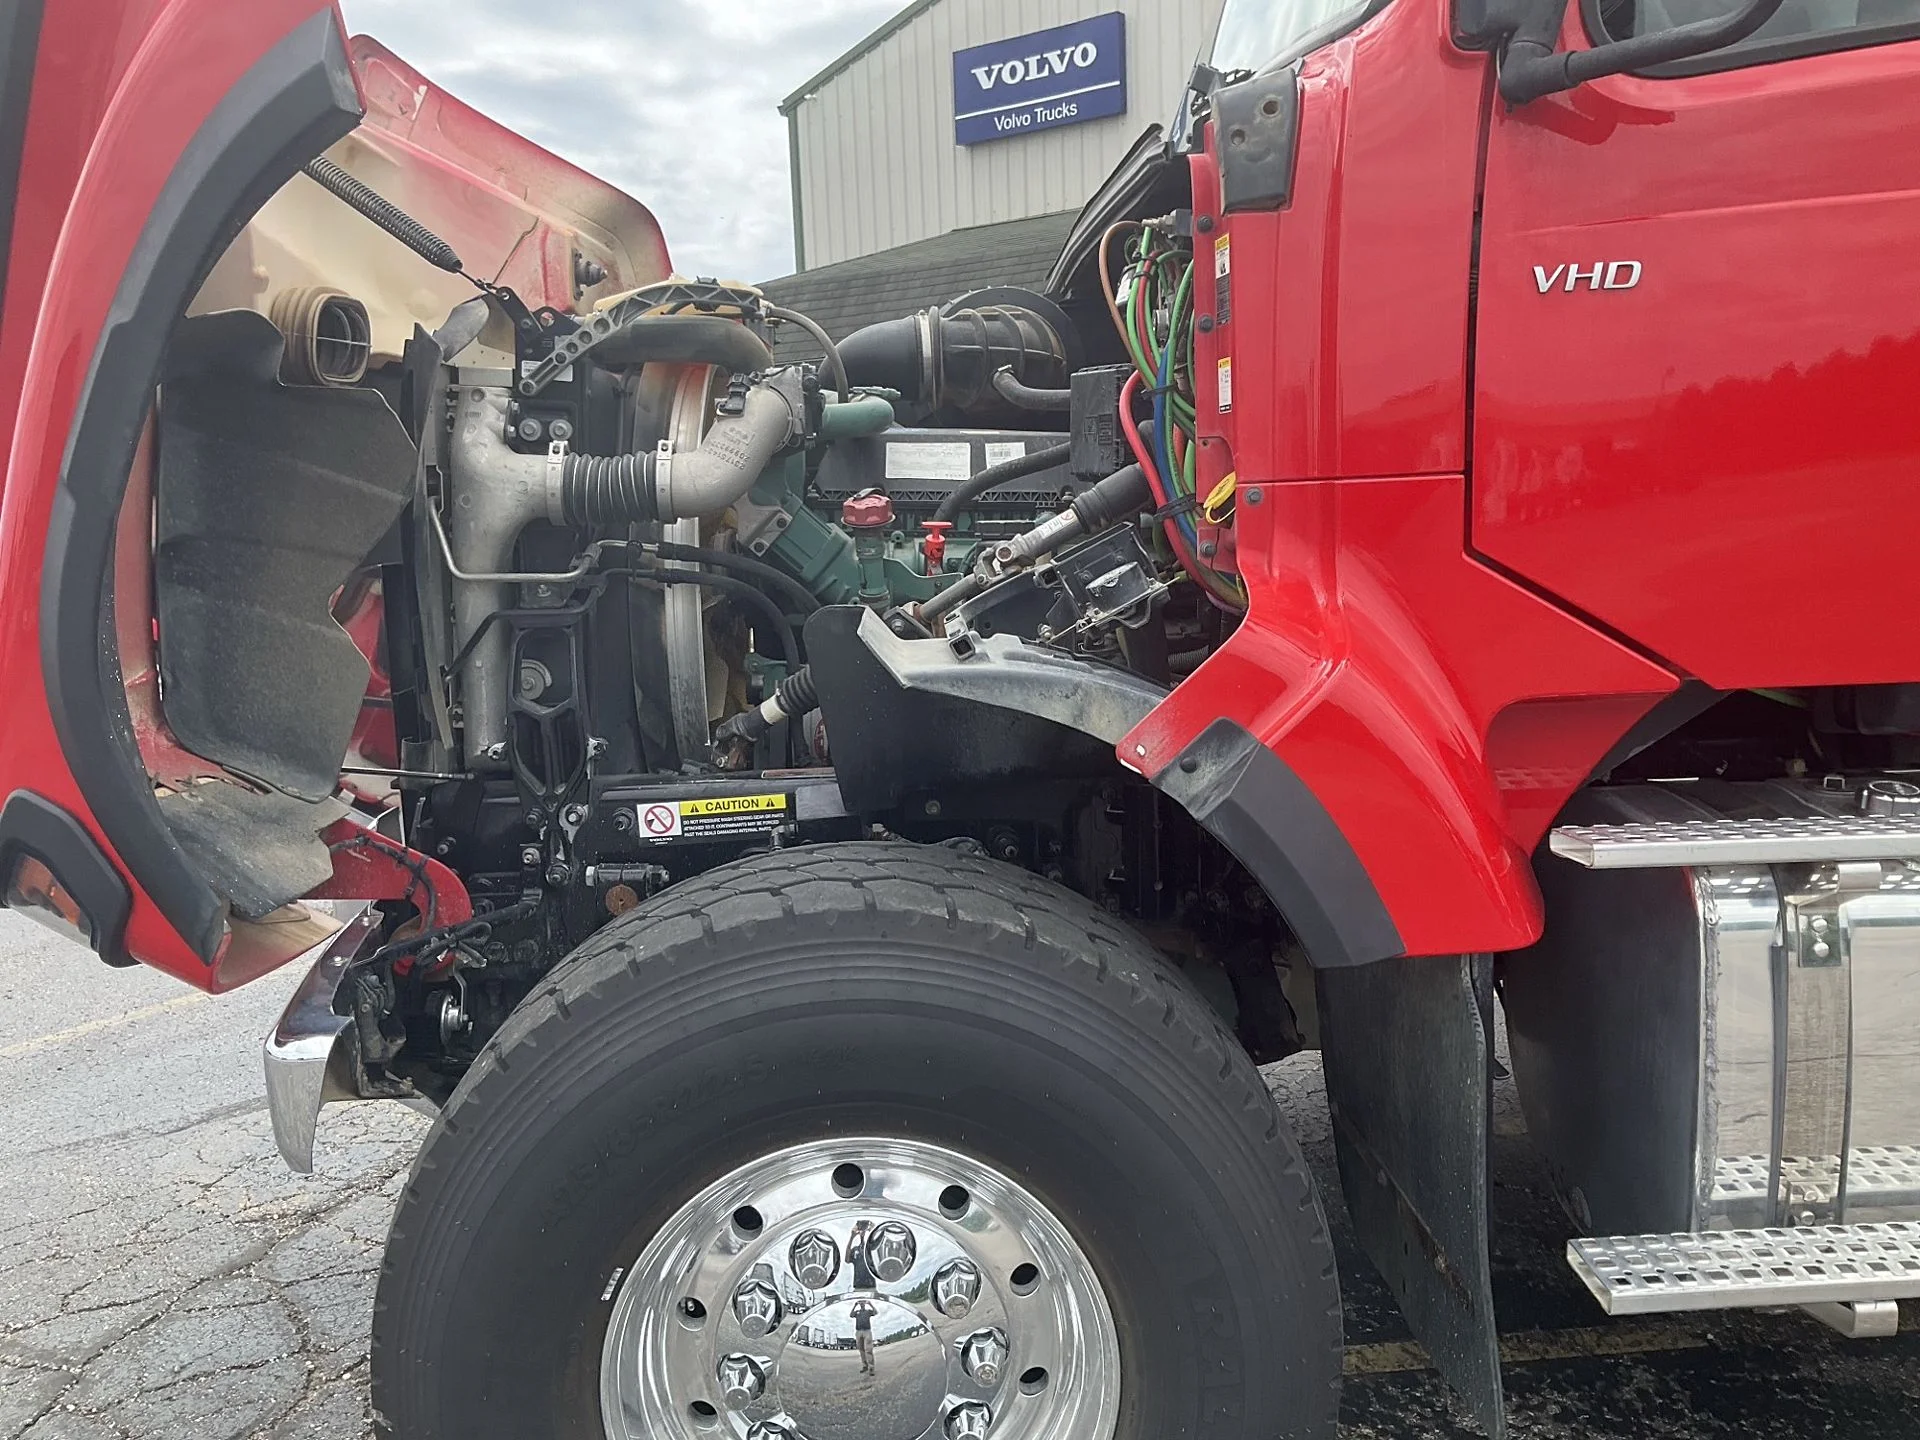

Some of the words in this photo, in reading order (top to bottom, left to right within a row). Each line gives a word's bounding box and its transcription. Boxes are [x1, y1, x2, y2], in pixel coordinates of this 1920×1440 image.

[971, 42, 1097, 90] VOLVO
[994, 113, 1031, 131] Volvo
[1034, 102, 1078, 124] Trucks
[1533, 261, 1642, 293] VHD
[705, 798, 759, 812] CAUTION
